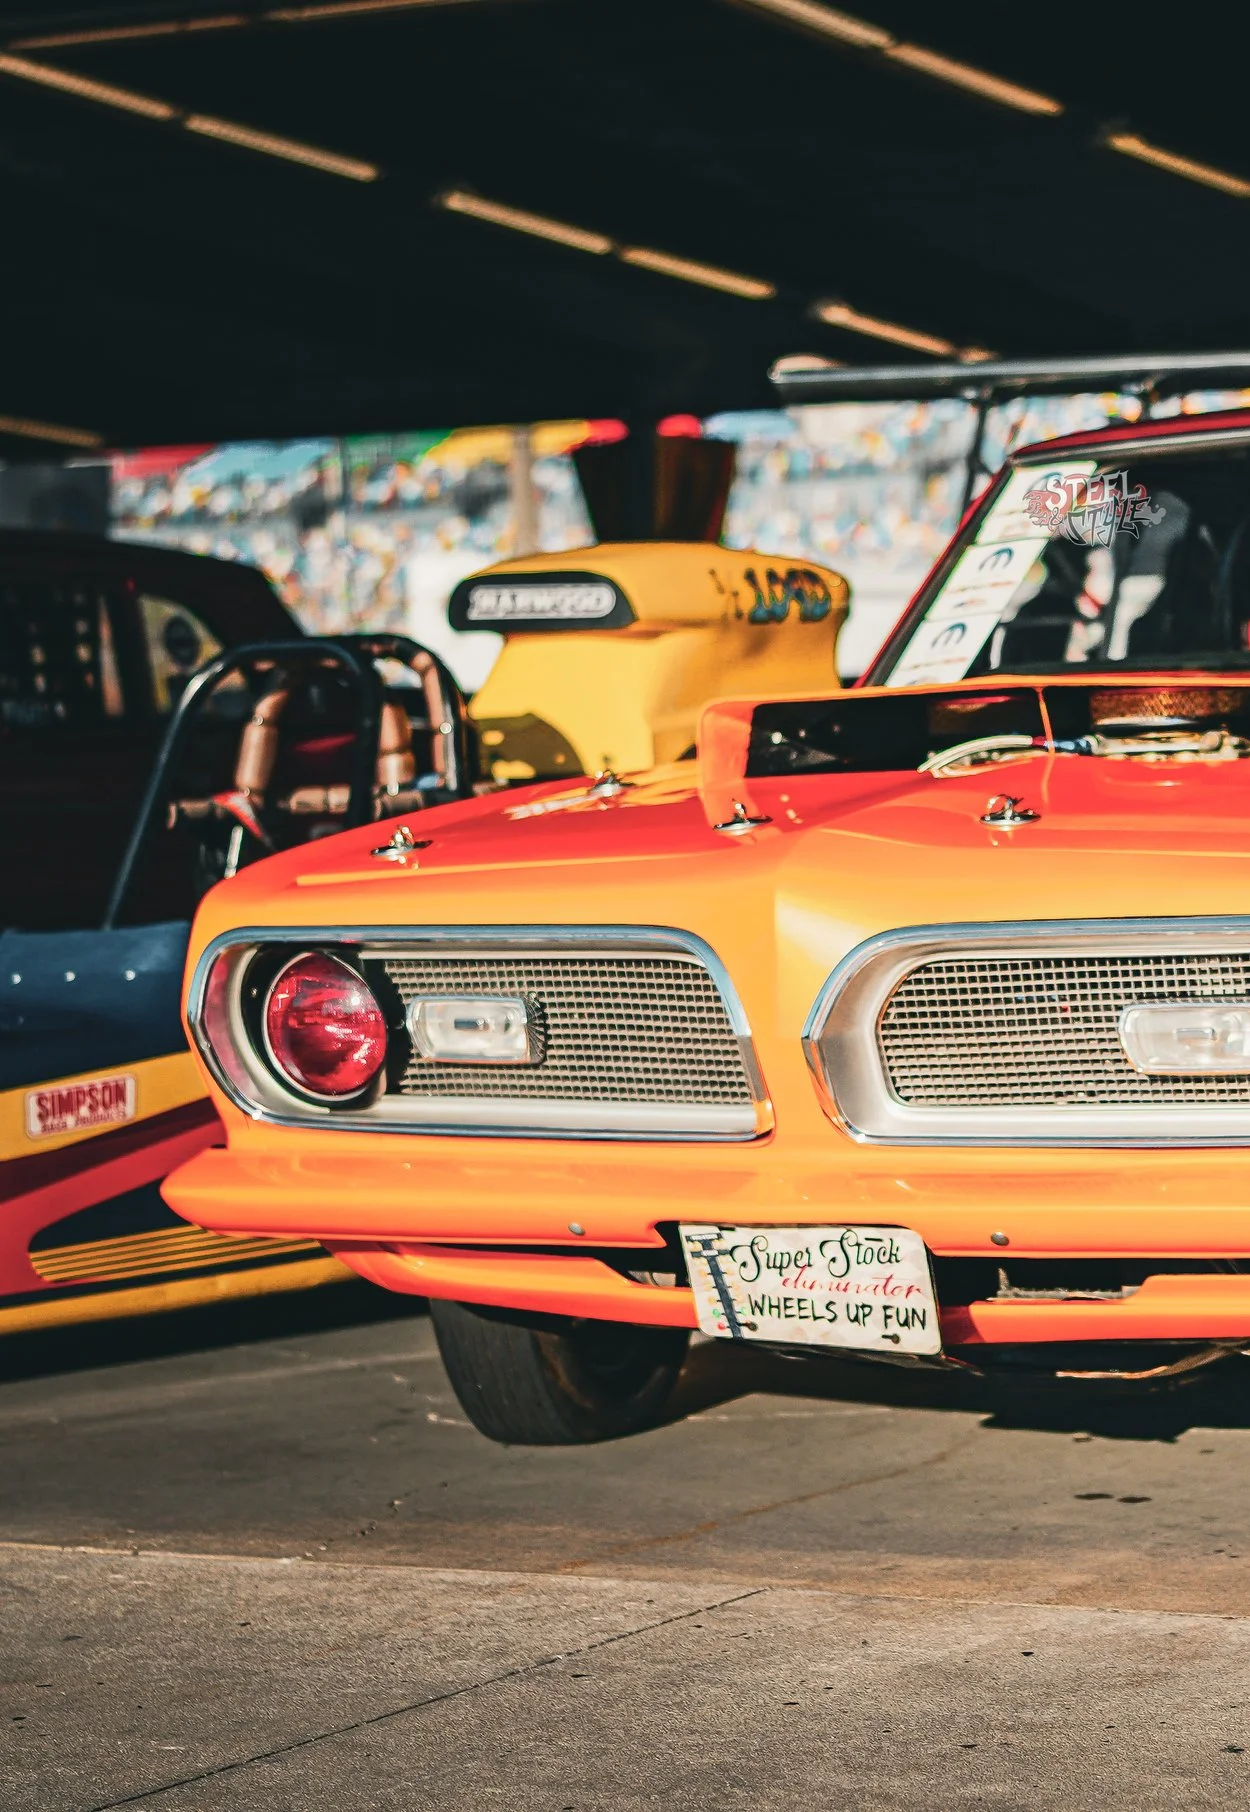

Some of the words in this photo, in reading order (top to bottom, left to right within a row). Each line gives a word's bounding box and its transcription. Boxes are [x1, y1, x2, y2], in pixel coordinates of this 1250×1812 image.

[1045, 470, 1140, 512] STEEL
[1050, 506, 1064, 526] &
[1067, 497, 1152, 550] STYLE
[37, 1080, 127, 1122] SIMPSON
[730, 1235, 813, 1282] Super
[820, 1229, 901, 1278] Stock
[749, 1294, 838, 1323] WHEELS
[846, 1303, 873, 1327] UP
[884, 1306, 927, 1331] FUN
